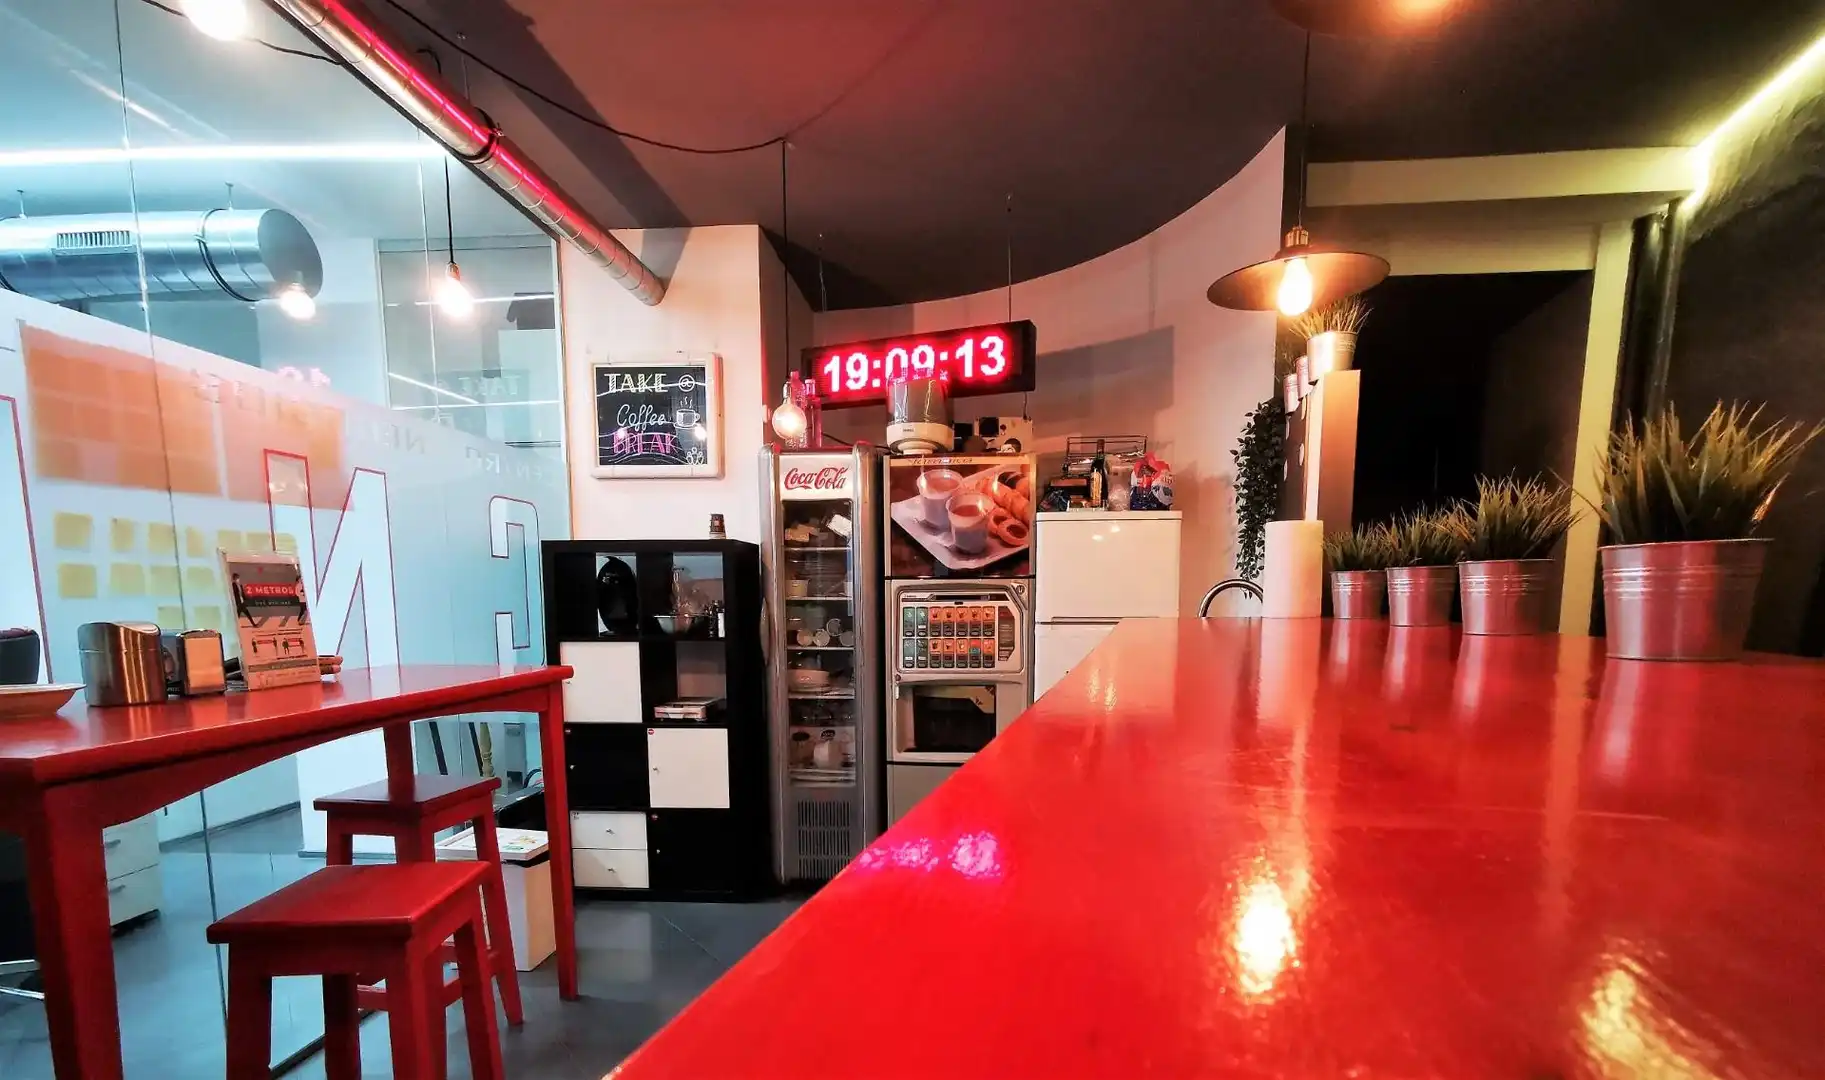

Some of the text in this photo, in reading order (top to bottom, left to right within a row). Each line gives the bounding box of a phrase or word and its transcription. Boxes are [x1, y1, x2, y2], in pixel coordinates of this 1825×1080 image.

[824, 336, 1006, 392] 19:09:13
[604, 373, 668, 393] TAKE
[617, 404, 667, 431] Coffee
[613, 431, 678, 455] BREAK
[784, 465, 849, 490] Coca-Cola
[246, 586, 294, 595] 2 METROS
